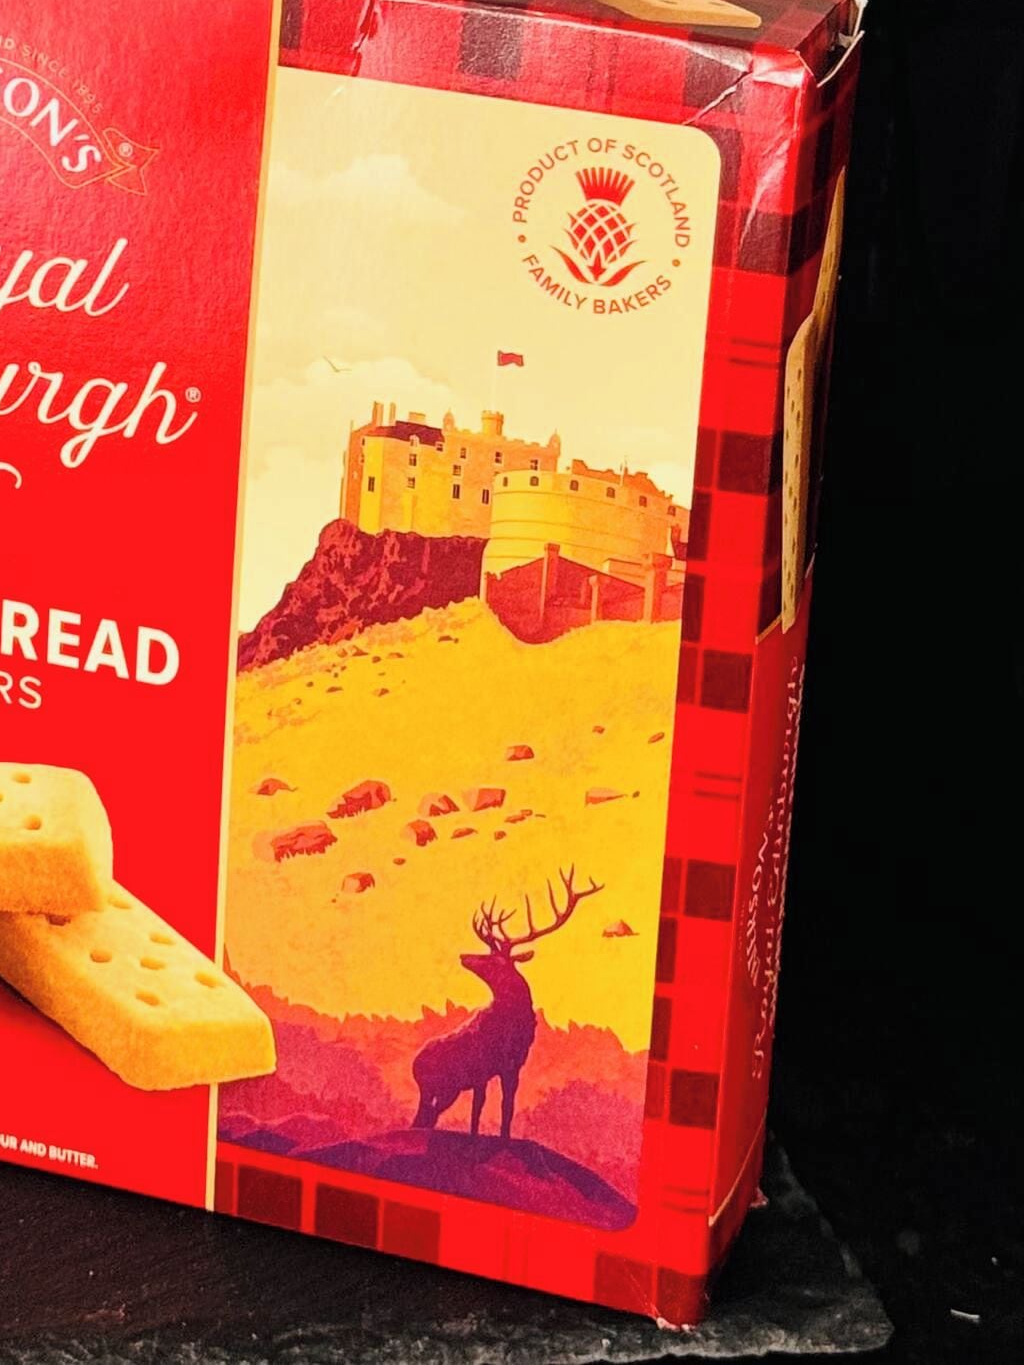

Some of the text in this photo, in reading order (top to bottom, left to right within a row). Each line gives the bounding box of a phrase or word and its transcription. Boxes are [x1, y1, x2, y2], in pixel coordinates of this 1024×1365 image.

[22, 45, 69, 78] SINCE
[513, 137, 691, 248] PRODUCT OF SCOTLAND
[522, 253, 672, 314] FAMILY BAKERS
[20, 1139, 47, 1157] AND
